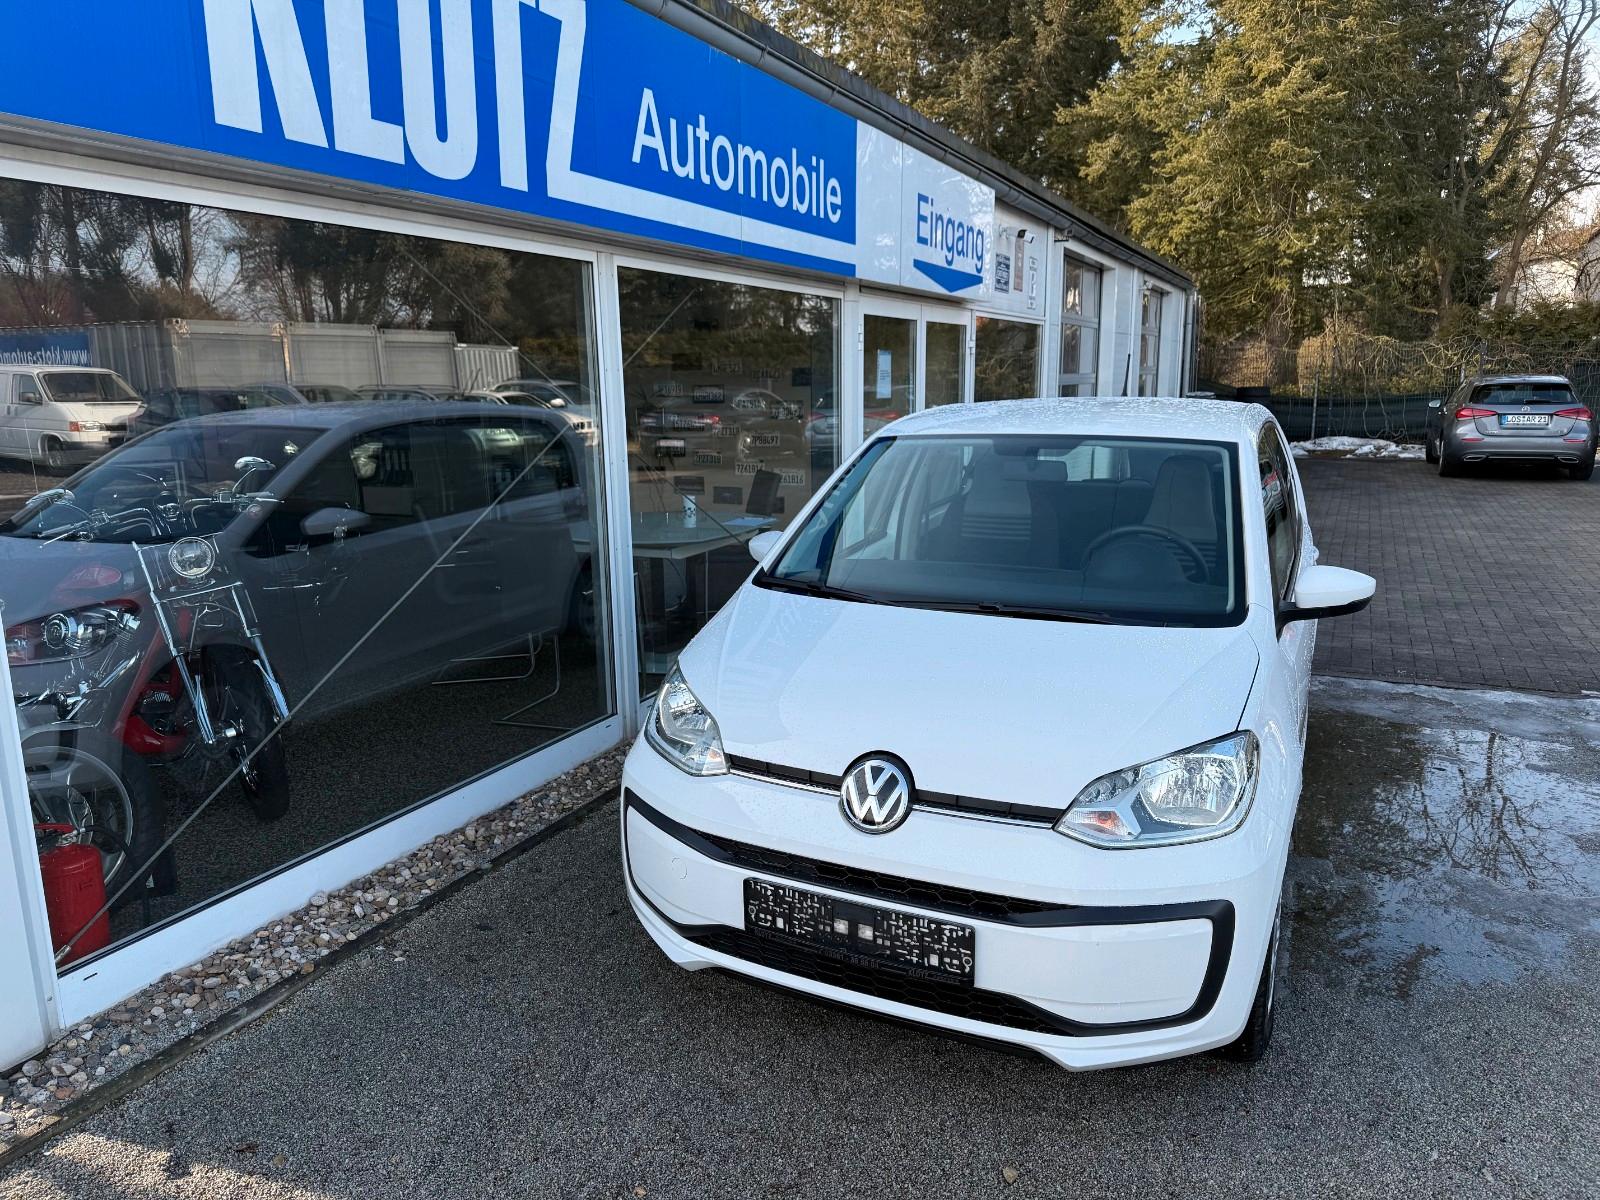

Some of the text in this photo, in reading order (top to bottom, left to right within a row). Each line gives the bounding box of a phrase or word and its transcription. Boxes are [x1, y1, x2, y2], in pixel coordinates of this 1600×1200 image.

[632, 87, 842, 224] Automobile
[916, 192, 984, 274] Eingang
[841, 760, 908, 829] VW
